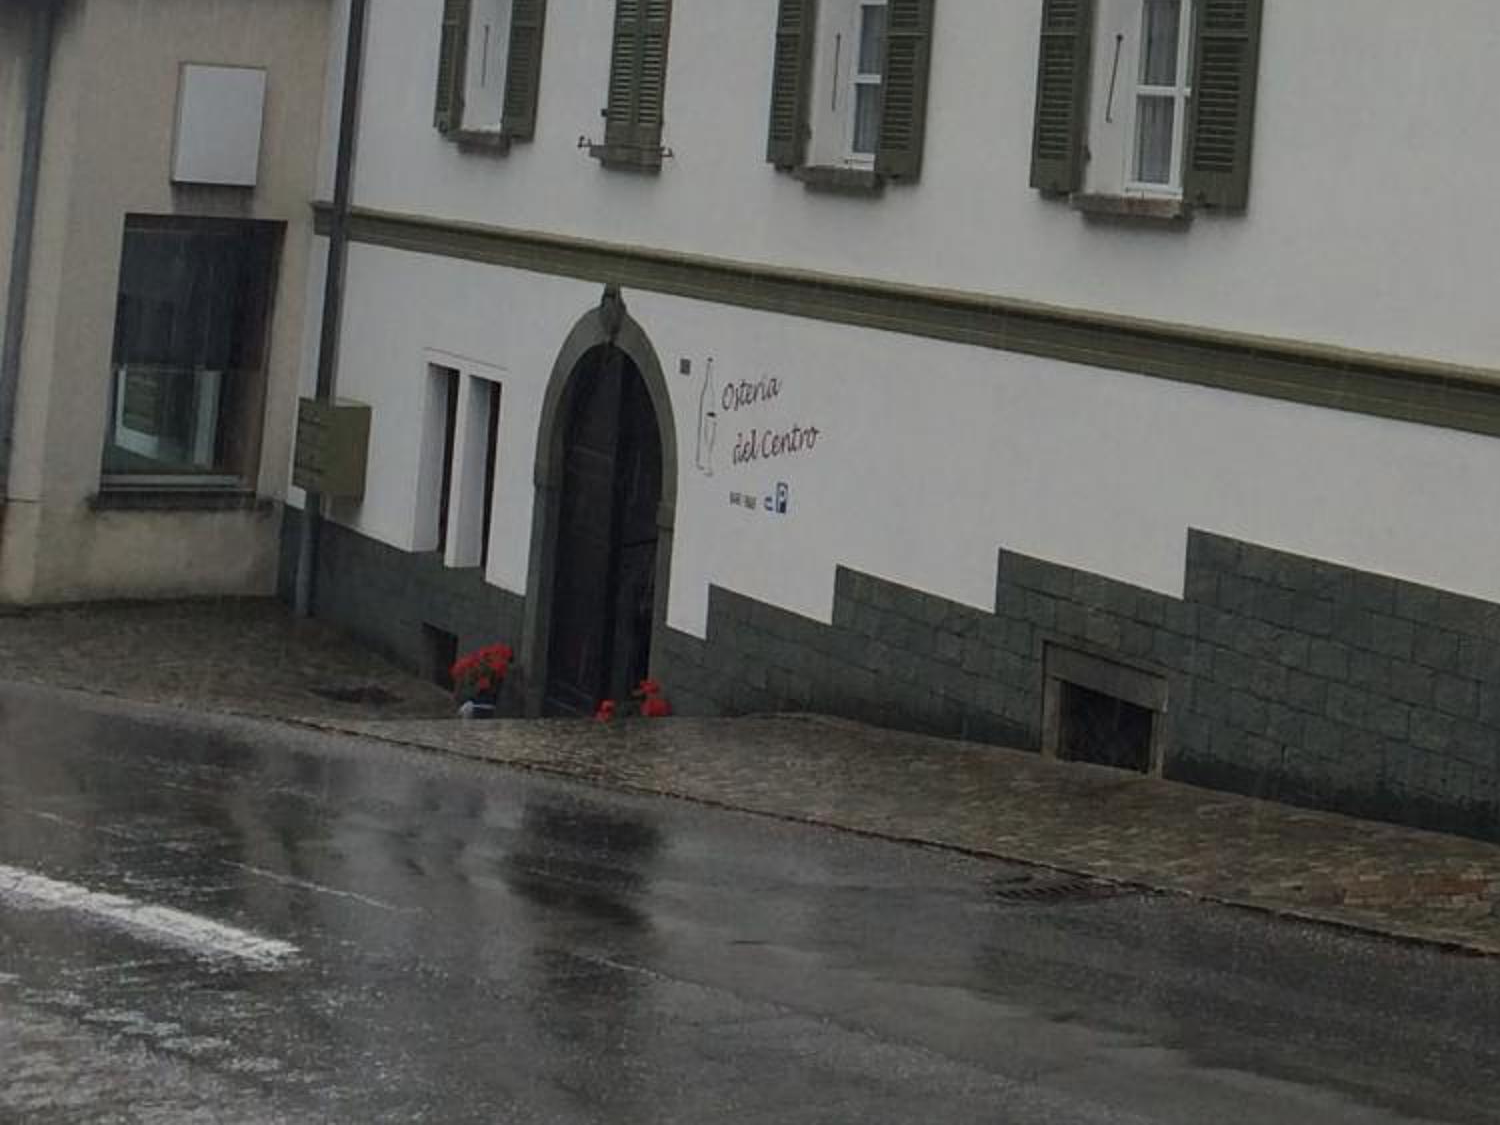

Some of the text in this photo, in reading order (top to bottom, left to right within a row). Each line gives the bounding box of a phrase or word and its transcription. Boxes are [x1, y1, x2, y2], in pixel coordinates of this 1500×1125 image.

[721, 377, 782, 411] Osteria
[732, 423, 820, 465] del Centro
